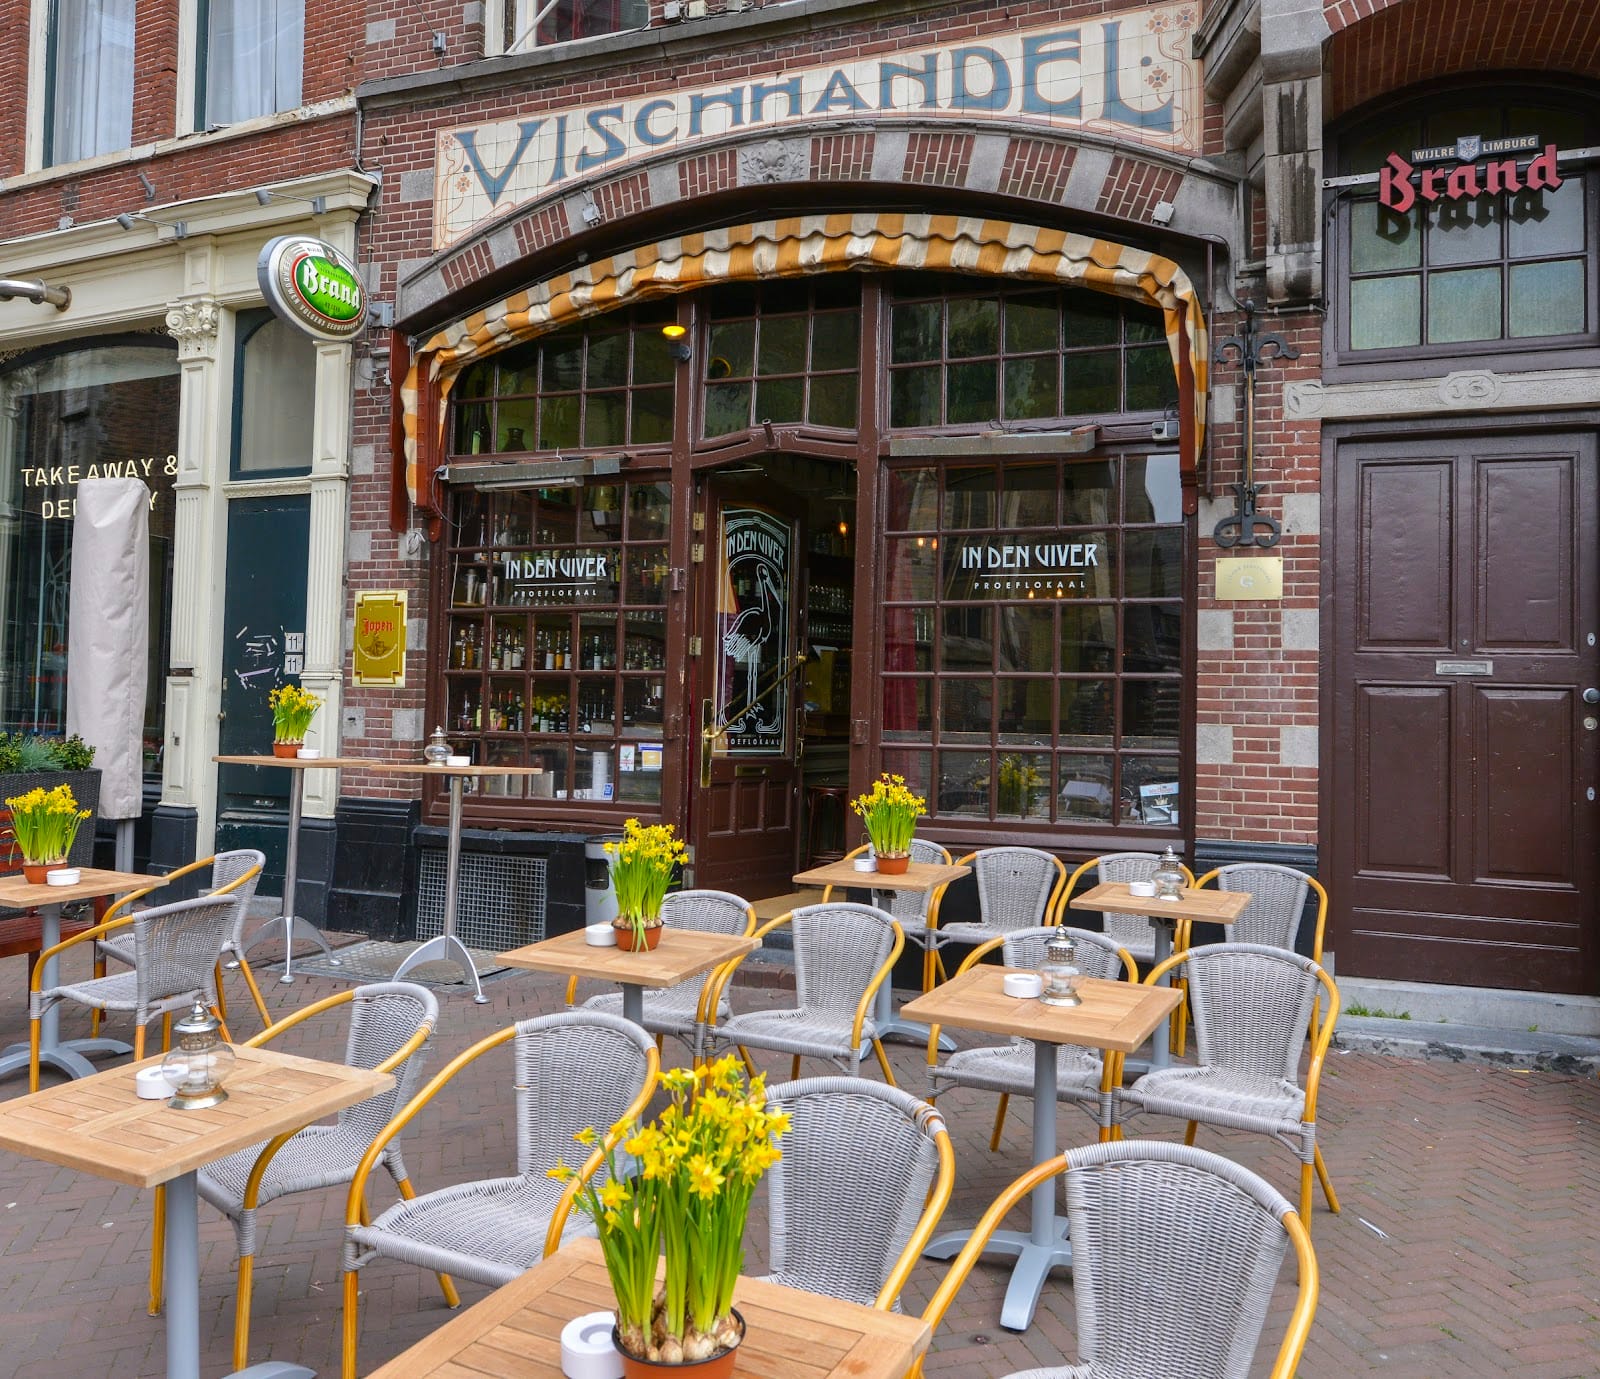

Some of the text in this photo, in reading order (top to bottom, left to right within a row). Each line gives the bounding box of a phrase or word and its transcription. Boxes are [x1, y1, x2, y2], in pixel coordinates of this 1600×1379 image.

[1414, 136, 1536, 160] WIJLRE LIMBURG
[1379, 144, 1563, 213] Brand
[303, 258, 360, 310] Brand
[164, 454, 179, 476] &
[726, 533, 736, 559] IN
[737, 530, 757, 552] DEN
[962, 546, 982, 569] IN
[987, 545, 1030, 568] DEN
[505, 559, 520, 580] IN
[524, 558, 556, 579] DEN
[514, 589, 597, 598] PROEFLOKAAL
[974, 580, 1085, 590] PROEFLOKAAL
[362, 618, 393, 637] Jopen
